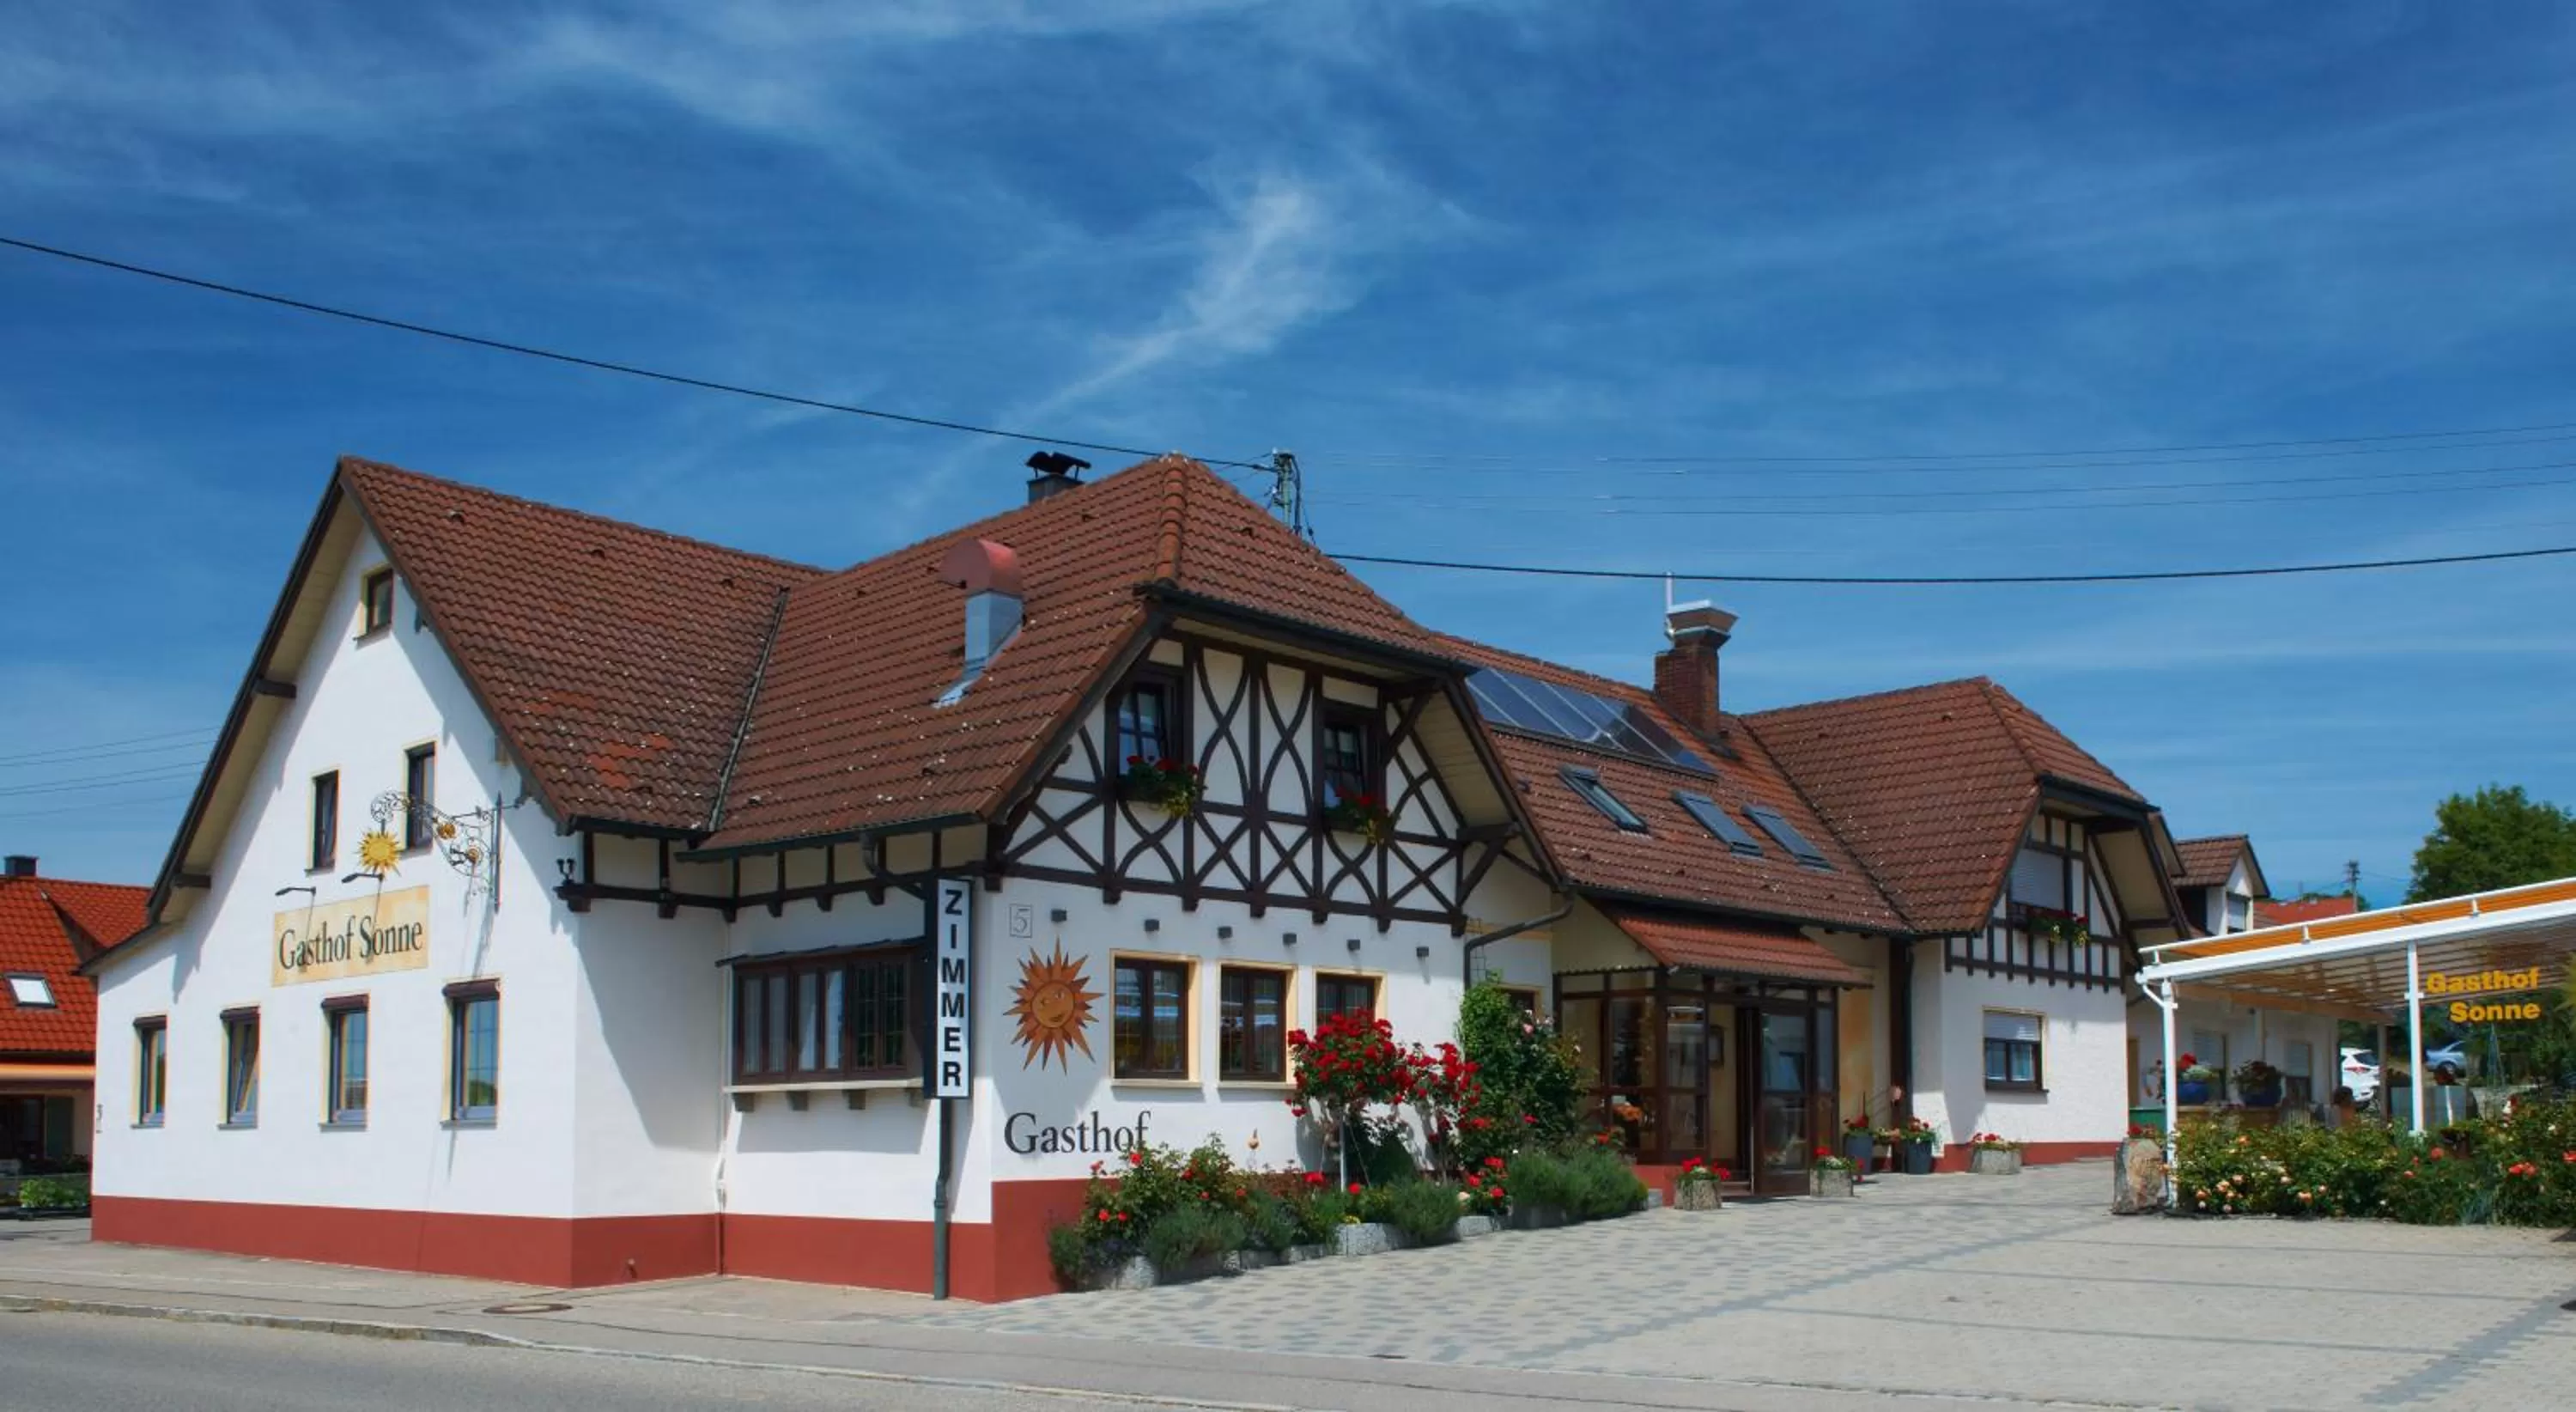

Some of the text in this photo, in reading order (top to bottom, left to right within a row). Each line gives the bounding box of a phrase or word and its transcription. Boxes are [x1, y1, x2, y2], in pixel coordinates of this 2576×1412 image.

[279, 915, 423, 970] Gasthof Sonne
[941, 889, 965, 1086] ZIMMER
[2426, 965, 2540, 994] Gasthof
[2449, 1001, 2541, 1022] Sonne
[1004, 1110, 1151, 1154] Gasthof
